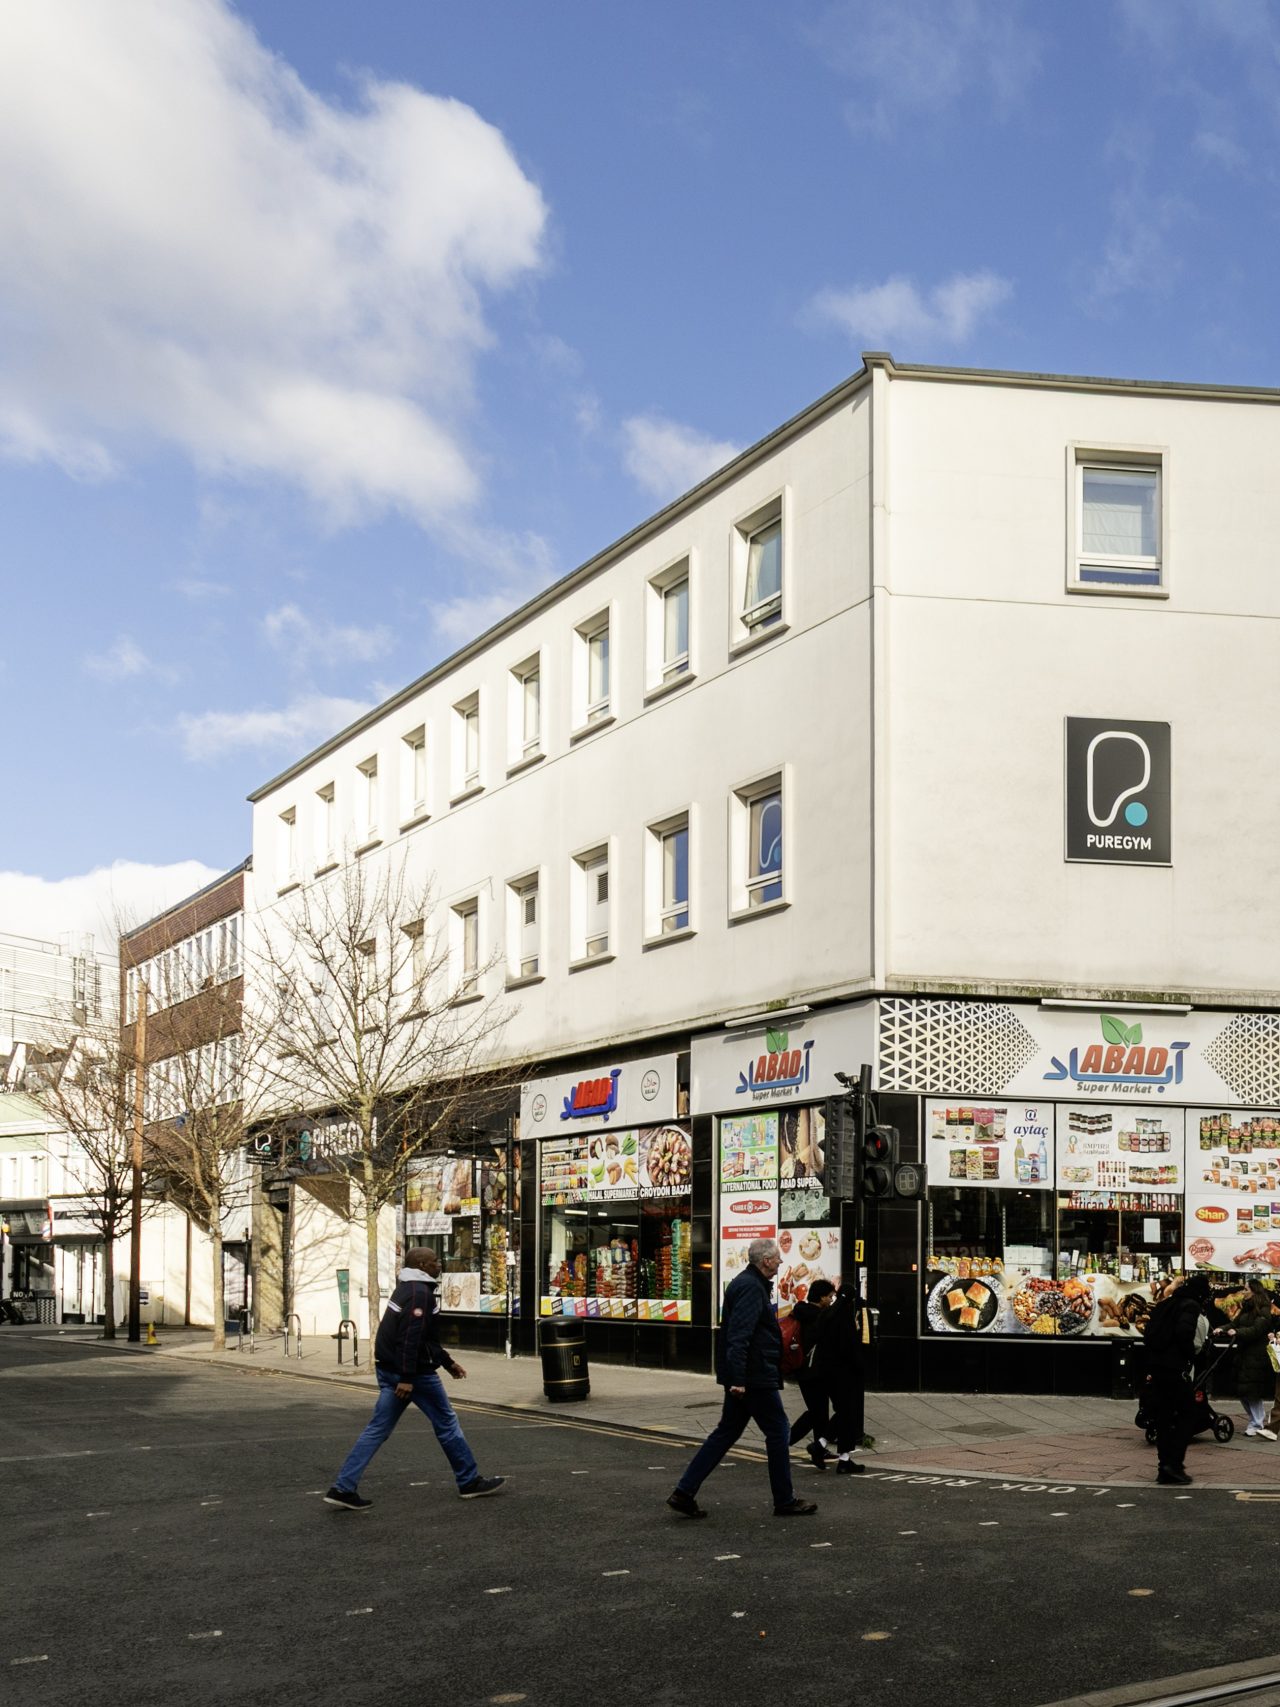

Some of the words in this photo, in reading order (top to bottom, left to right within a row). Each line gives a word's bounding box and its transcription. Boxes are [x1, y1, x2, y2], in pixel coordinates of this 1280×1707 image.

[1087, 834, 1151, 850] PUREGYM
[754, 1049, 802, 1083] ABAD
[1079, 1044, 1169, 1075] ABAD
[752, 1089, 769, 1101] Super
[771, 1087, 793, 1097] Market
[1077, 1081, 1110, 1093] Super
[1111, 1083, 1152, 1094] Market
[1014, 1125, 1048, 1138] aytaç
[721, 1181, 761, 1192] INTERNATIONAL
[762, 1180, 777, 1189] FOOD
[780, 1178, 796, 1188] ABAD
[604, 1188, 638, 1199] SUPERMARKET
[640, 1186, 670, 1198] CROYDON
[1197, 1208, 1226, 1220] Shan
[851, 1472, 982, 1487] RIGHT
[990, 1482, 1112, 1497] LOOK
